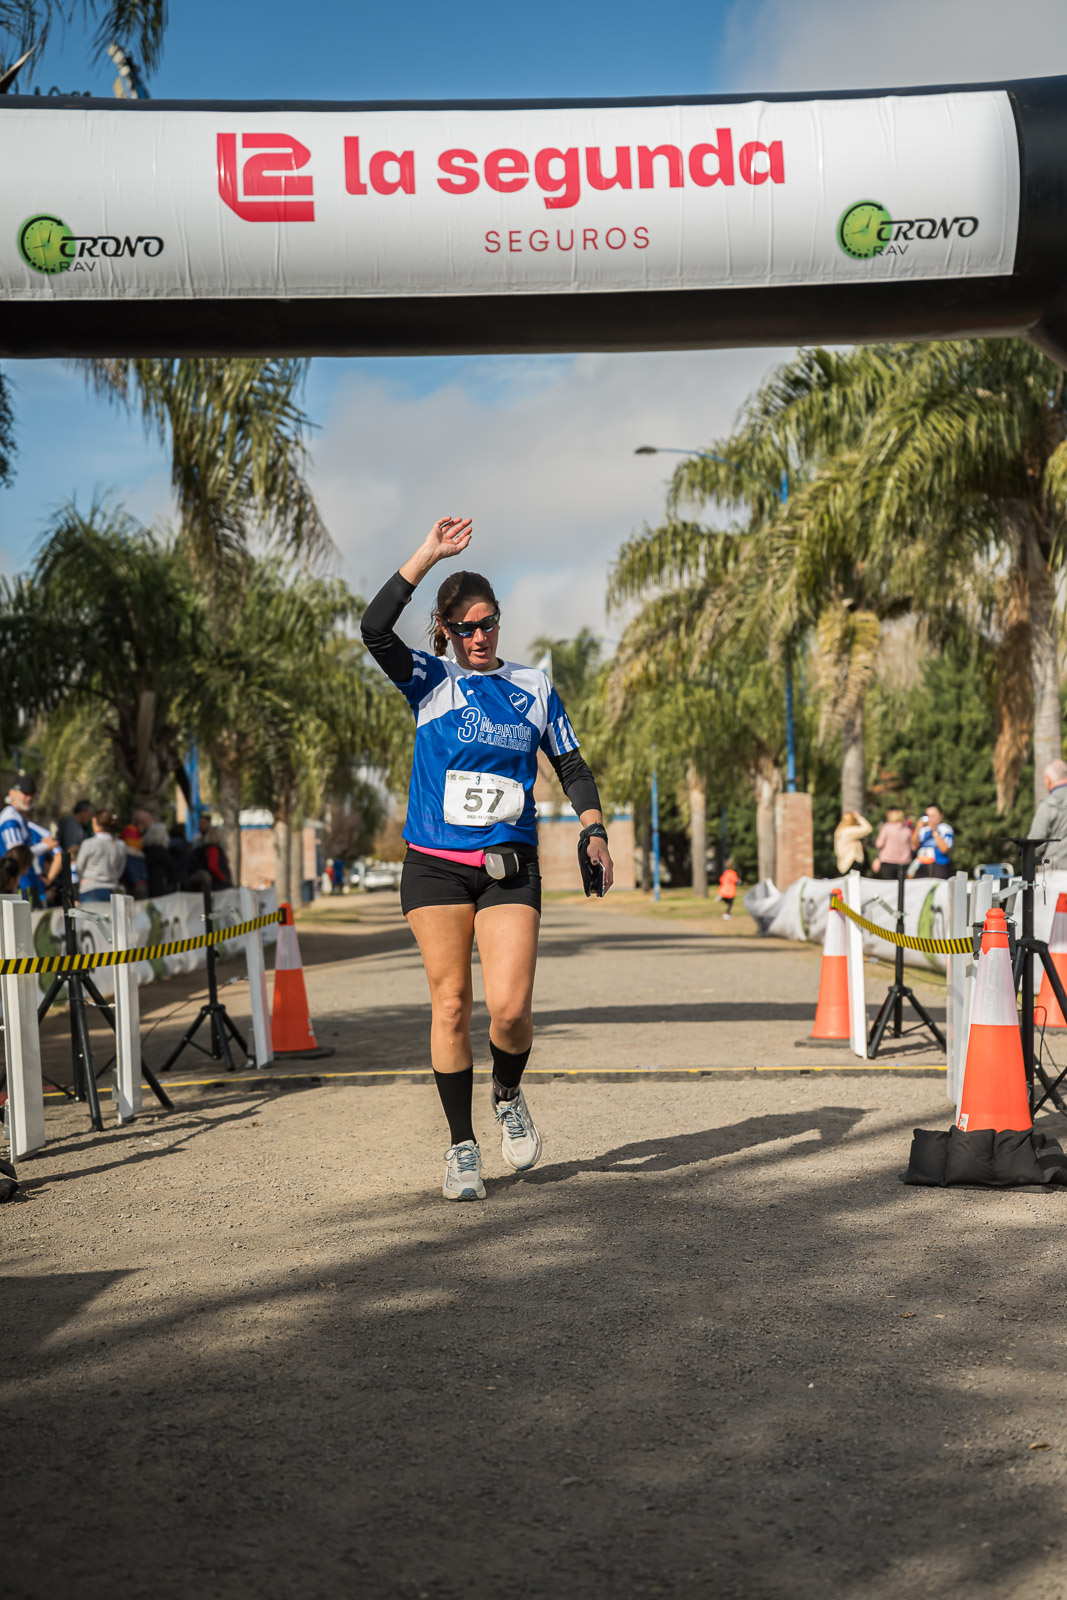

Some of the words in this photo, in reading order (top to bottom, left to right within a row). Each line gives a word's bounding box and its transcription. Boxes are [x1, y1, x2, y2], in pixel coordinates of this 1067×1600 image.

[343, 135, 416, 195] la
[436, 127, 785, 209] segunda
[484, 226, 650, 253] SEGUROS
[876, 216, 979, 242] CRONO
[60, 236, 164, 258] CRONO
[873, 244, 909, 257] RAV
[60, 261, 96, 272] RAV
[457, 706, 481, 743] 3
[463, 788, 505, 813] 57
